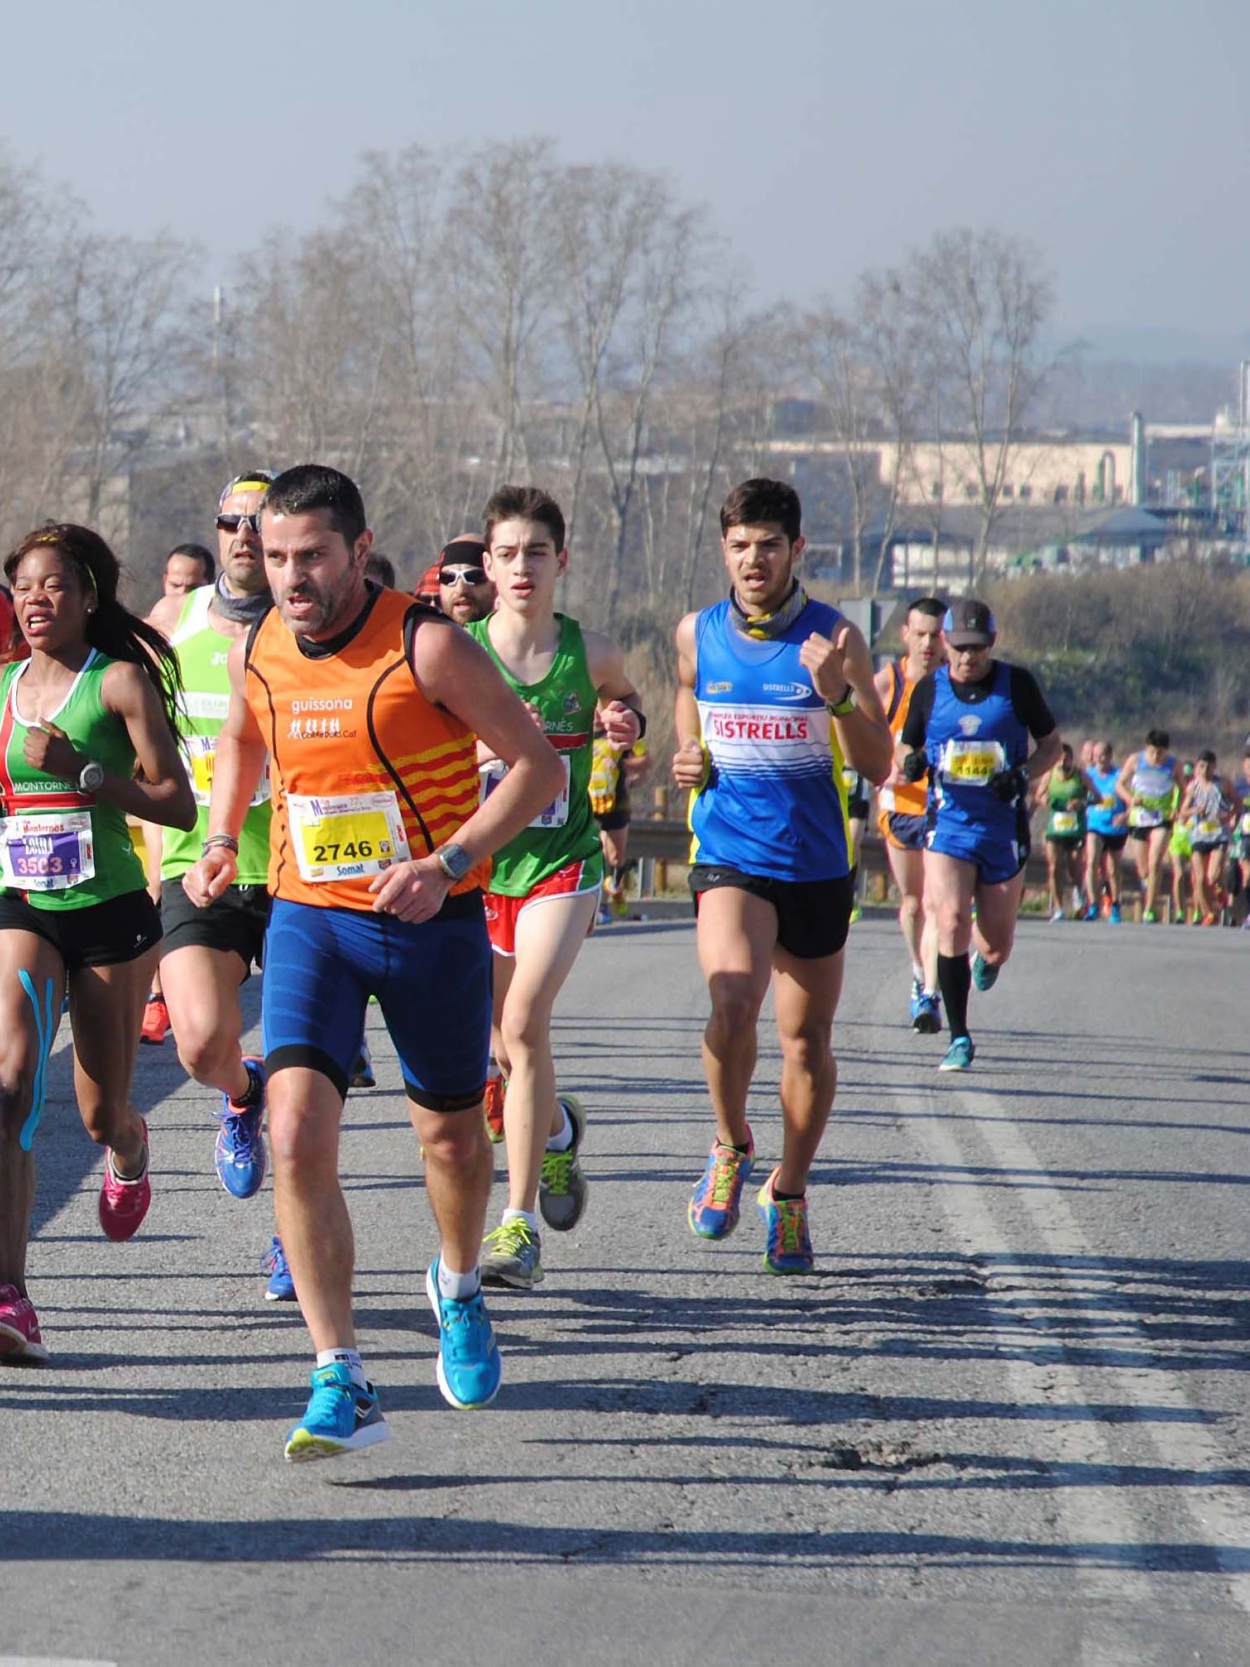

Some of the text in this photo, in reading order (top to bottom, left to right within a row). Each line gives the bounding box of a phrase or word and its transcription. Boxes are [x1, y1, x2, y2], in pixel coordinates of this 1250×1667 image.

[292, 696, 353, 714] guissona
[714, 720, 808, 740] SISTRELLS
[313, 840, 372, 862] 2746
[18, 856, 63, 874] 3503
[337, 864, 365, 876] Somat
